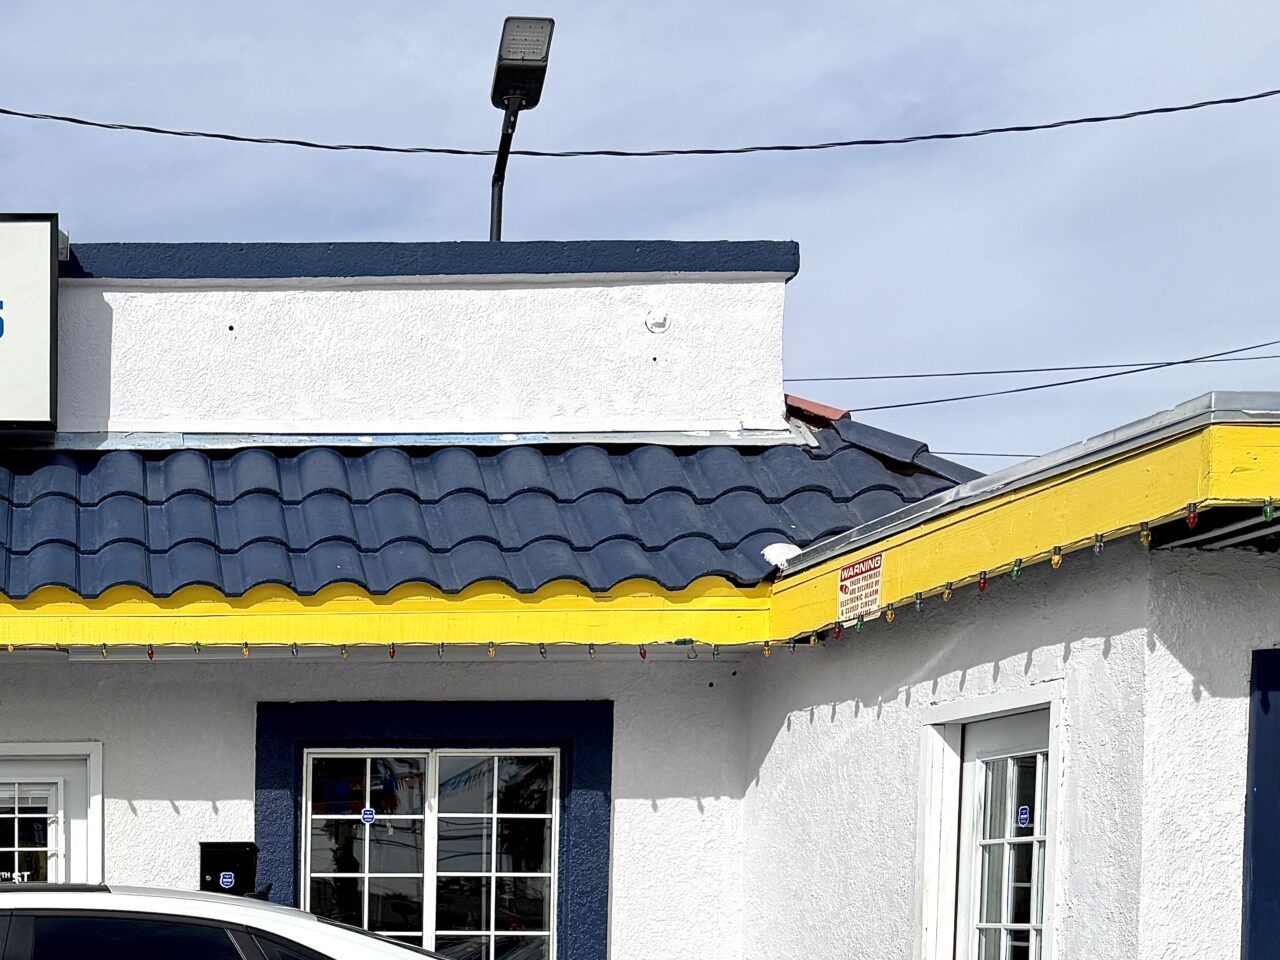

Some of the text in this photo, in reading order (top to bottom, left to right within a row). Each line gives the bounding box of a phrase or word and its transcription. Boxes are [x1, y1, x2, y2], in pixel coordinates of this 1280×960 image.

[841, 556, 881, 580] WARNING
[861, 570, 881, 585] PREMISES
[849, 579, 880, 596] ARE SECURED BY
[840, 588, 879, 608] ELECTRONIC ALARM
[12, 871, 30, 883] ST
